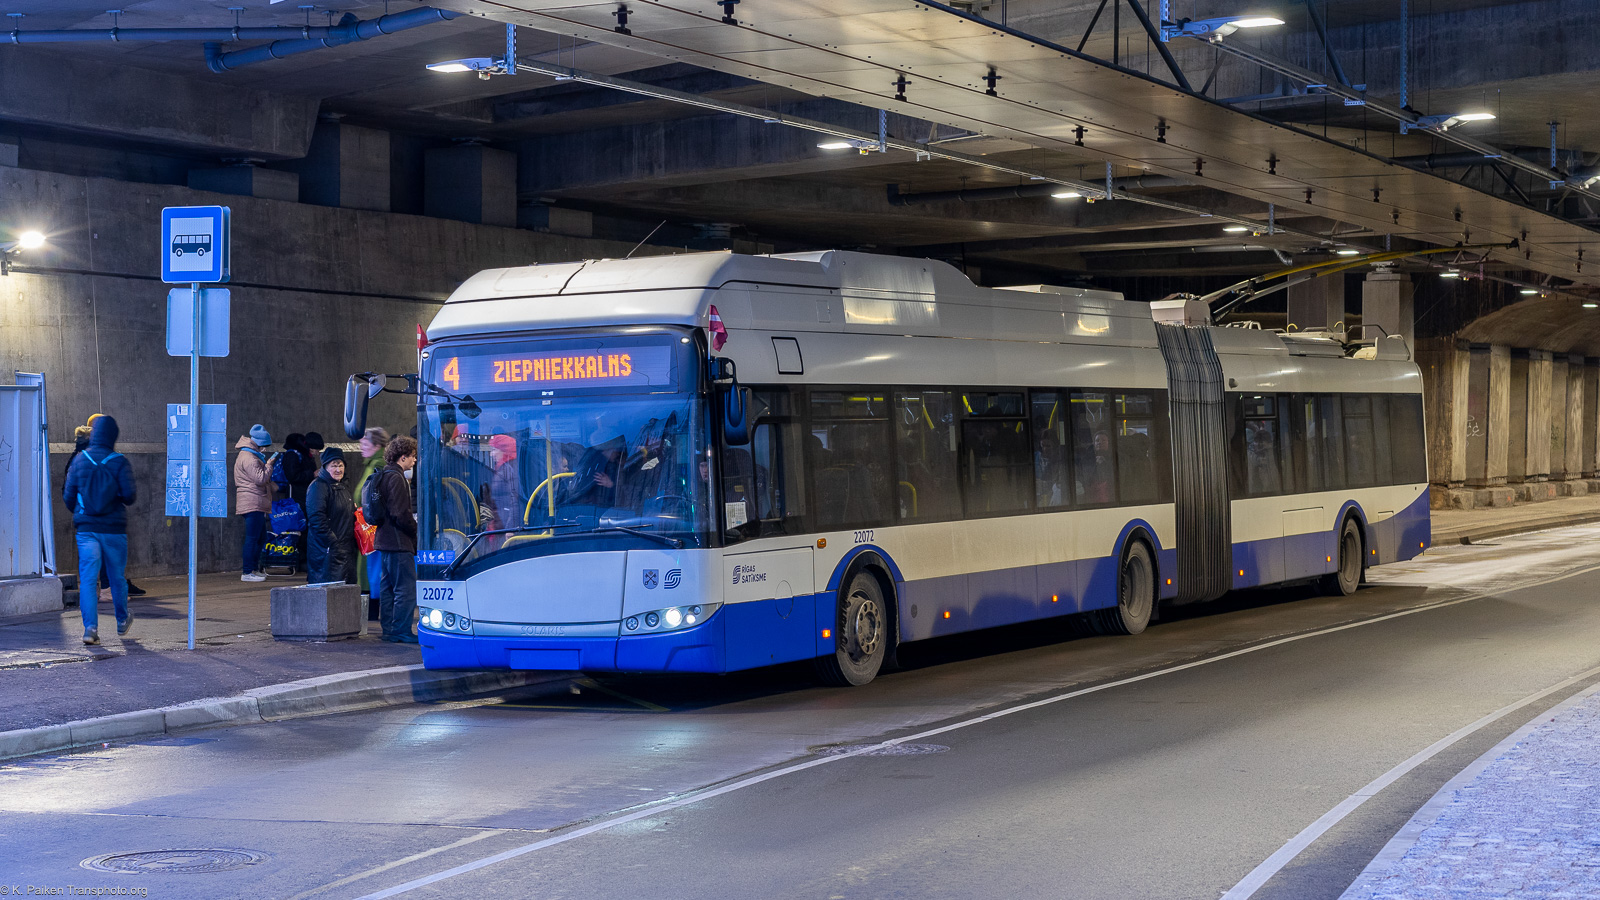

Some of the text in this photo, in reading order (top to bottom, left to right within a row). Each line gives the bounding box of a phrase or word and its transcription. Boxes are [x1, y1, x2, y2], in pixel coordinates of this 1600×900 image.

[443, 354, 632, 391] 4 ZIEPNIEKKALNS
[854, 530, 875, 544] 22072
[422, 587, 454, 601] 22072
[520, 626, 565, 636] SOLARIS
